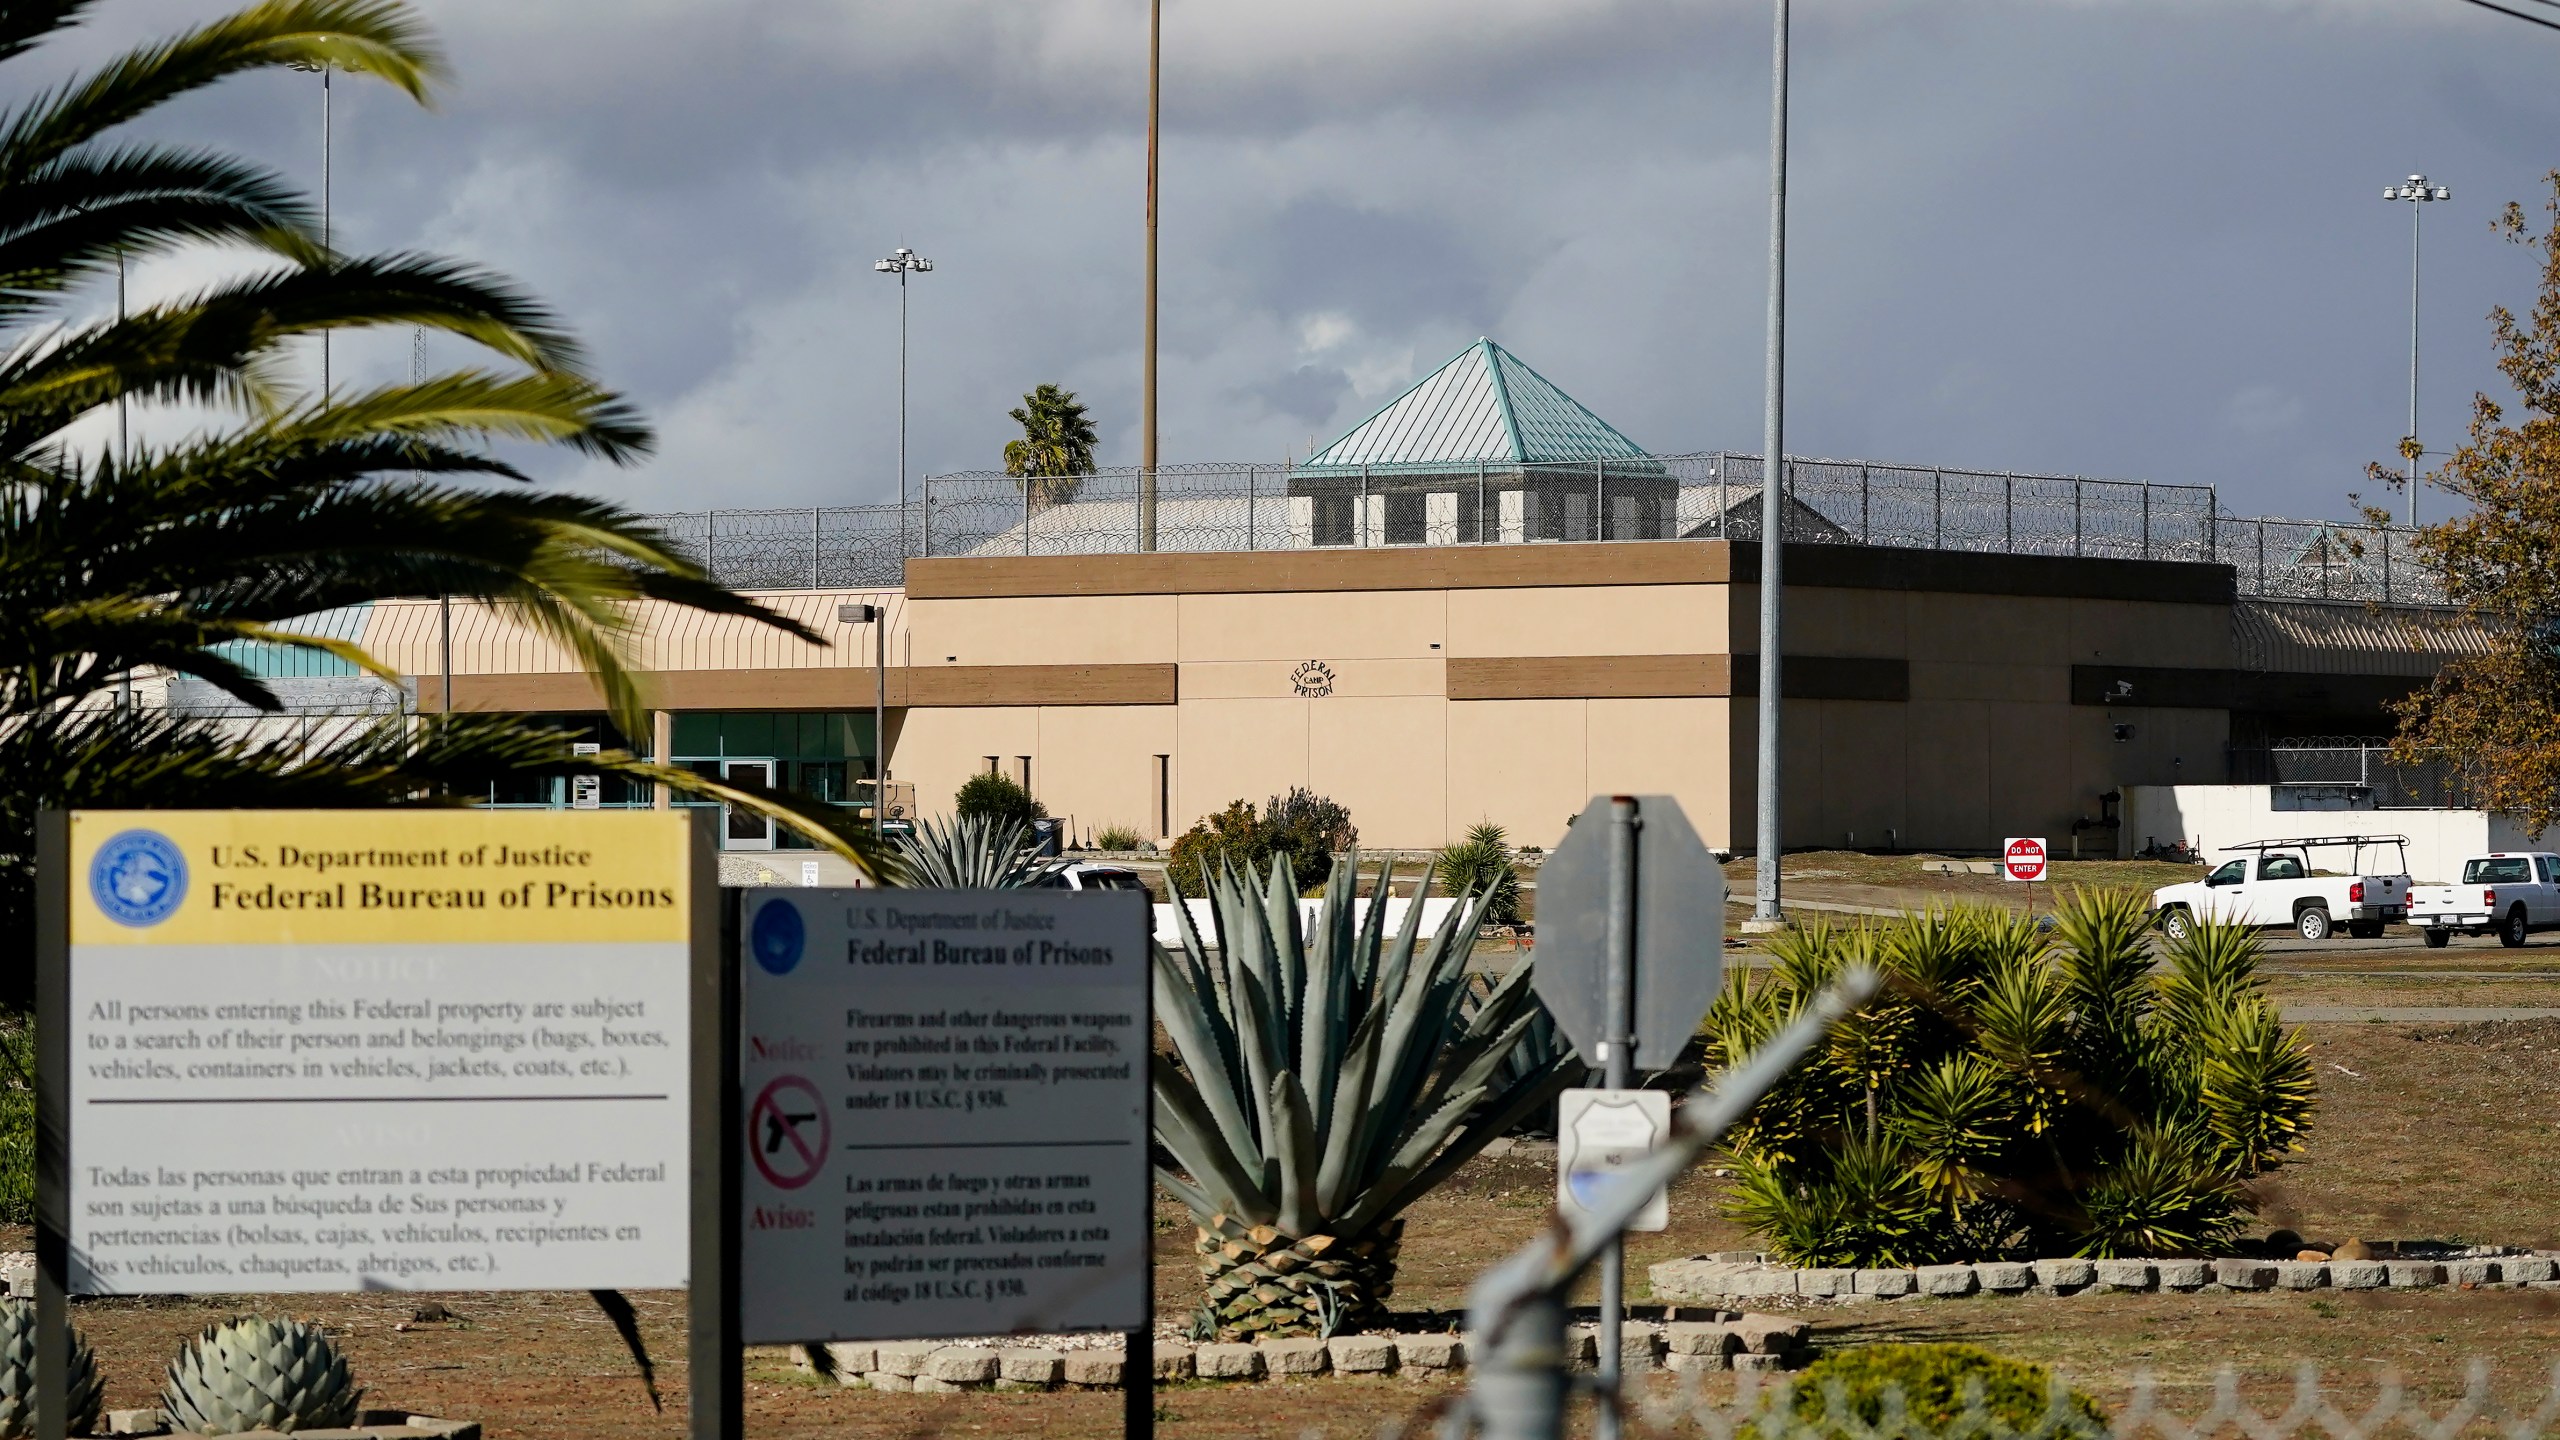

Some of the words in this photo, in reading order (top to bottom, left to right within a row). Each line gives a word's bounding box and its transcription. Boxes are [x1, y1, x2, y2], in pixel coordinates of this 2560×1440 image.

[1290, 660, 1336, 683] FEDERAL
[1294, 684, 1333, 698] PRISON
[211, 846, 268, 868] U.S.
[280, 845, 448, 871] Department
[459, 845, 487, 867] of
[494, 844, 591, 867] Justice
[2025, 846, 2040, 854] NOT
[213, 883, 344, 909] Federal
[360, 883, 485, 909] Bureau
[499, 882, 535, 907] of
[547, 882, 673, 907] Prisons
[846, 907, 880, 930] U.S.
[886, 907, 978, 935] Department
[981, 908, 1000, 930] of
[1003, 908, 1054, 930] Justice
[848, 939, 926, 965] Federal
[933, 939, 1007, 965] Bureau
[1013, 940, 1034, 965] of
[1039, 940, 1112, 965] Prisons
[314, 957, 447, 983] NOTICE
[89, 1000, 121, 1021] All
[128, 1006, 209, 1026] persons
[215, 1000, 302, 1025] entering
[308, 999, 347, 1019] this
[354, 999, 431, 1019] Federal
[438, 1002, 525, 1025] property
[532, 1003, 565, 1018] are
[571, 998, 644, 1023] subject
[846, 1009, 914, 1028] Firearms
[918, 1009, 946, 1028] and
[949, 1010, 989, 1028] other
[992, 1009, 1067, 1032] dangerous
[1070, 1014, 1131, 1032] weapons
[88, 1032, 109, 1050] to
[115, 1035, 127, 1050] a
[133, 1029, 201, 1050] search
[207, 1029, 233, 1049] of
[236, 1028, 285, 1049] their
[291, 1033, 361, 1054] person
[367, 1028, 405, 1048] and
[411, 1028, 526, 1053] belongings
[532, 1026, 595, 1052] (bags,
[602, 1026, 668, 1047] boxes,
[846, 1040, 870, 1054] are
[873, 1036, 951, 1059] prohibited
[955, 1036, 970, 1053] in
[973, 1035, 1000, 1054] this
[1004, 1035, 1059, 1053] Federal
[1063, 1034, 1119, 1056] Facility.
[88, 1058, 181, 1081] vehicles,
[187, 1058, 296, 1078] containers
[303, 1058, 323, 1077] in
[330, 1057, 422, 1079] vehicles,
[425, 1057, 507, 1082] jackets,
[513, 1059, 574, 1077] coats,
[846, 1063, 915, 1082] Violators
[918, 1065, 948, 1086] may
[953, 1063, 972, 1081] be
[974, 1063, 1047, 1085] criminally
[1053, 1062, 1130, 1084] prosecuted
[846, 1091, 890, 1110] under
[895, 1090, 911, 1109] 18
[915, 1090, 961, 1109] U.S.C.
[977, 1089, 1007, 1109] 930.
[87, 1166, 151, 1187] Todas
[158, 1165, 187, 1186] las
[193, 1171, 286, 1191] personas
[292, 1170, 330, 1190] que
[337, 1168, 403, 1185] entran
[409, 1170, 421, 1184] a
[428, 1168, 469, 1185] esta
[475, 1163, 580, 1189] propiedad
[588, 1161, 665, 1182] Federal
[846, 1174, 873, 1194] Las
[876, 1179, 923, 1193] armas
[926, 1173, 945, 1191] de
[948, 1173, 989, 1195] fuego
[992, 1177, 1000, 1195] y
[1004, 1175, 1042, 1190] otras
[1046, 1175, 1090, 1188] armas
[86, 1201, 124, 1217] son
[130, 1195, 203, 1221] sujetas
[209, 1200, 221, 1215] a
[228, 1200, 266, 1215] una
[378, 1193, 404, 1214] de
[410, 1193, 449, 1214] Sus
[455, 1198, 547, 1218] personas
[554, 1198, 565, 1218] y
[751, 1205, 815, 1229] Aviso:
[845, 1201, 920, 1225] peligrosas
[965, 1199, 1044, 1221] prohibidas
[1046, 1202, 1064, 1215] en
[1067, 1199, 1096, 1214] esta
[88, 1225, 221, 1251] pertenencias
[227, 1224, 309, 1247] (bolsas,
[315, 1225, 375, 1249] cajas,
[496, 1222, 610, 1247] recipientes
[615, 1226, 640, 1241] en
[929, 1227, 984, 1246] federal.
[988, 1226, 1065, 1244] Violadores
[1069, 1230, 1077, 1242] a
[1081, 1226, 1109, 1241] esta
[87, 1256, 118, 1275] los
[239, 1252, 350, 1278] chaquetas,
[357, 1252, 441, 1278] abrigos,
[844, 1256, 865, 1279] ley
[928, 1258, 950, 1272] ser
[954, 1253, 1034, 1275] procesados
[1037, 1251, 1106, 1268] conforme
[844, 1284, 859, 1302] al
[915, 1281, 931, 1299] 18
[935, 1280, 981, 1299] U.S.C.
[997, 1278, 1027, 1298] 930.
